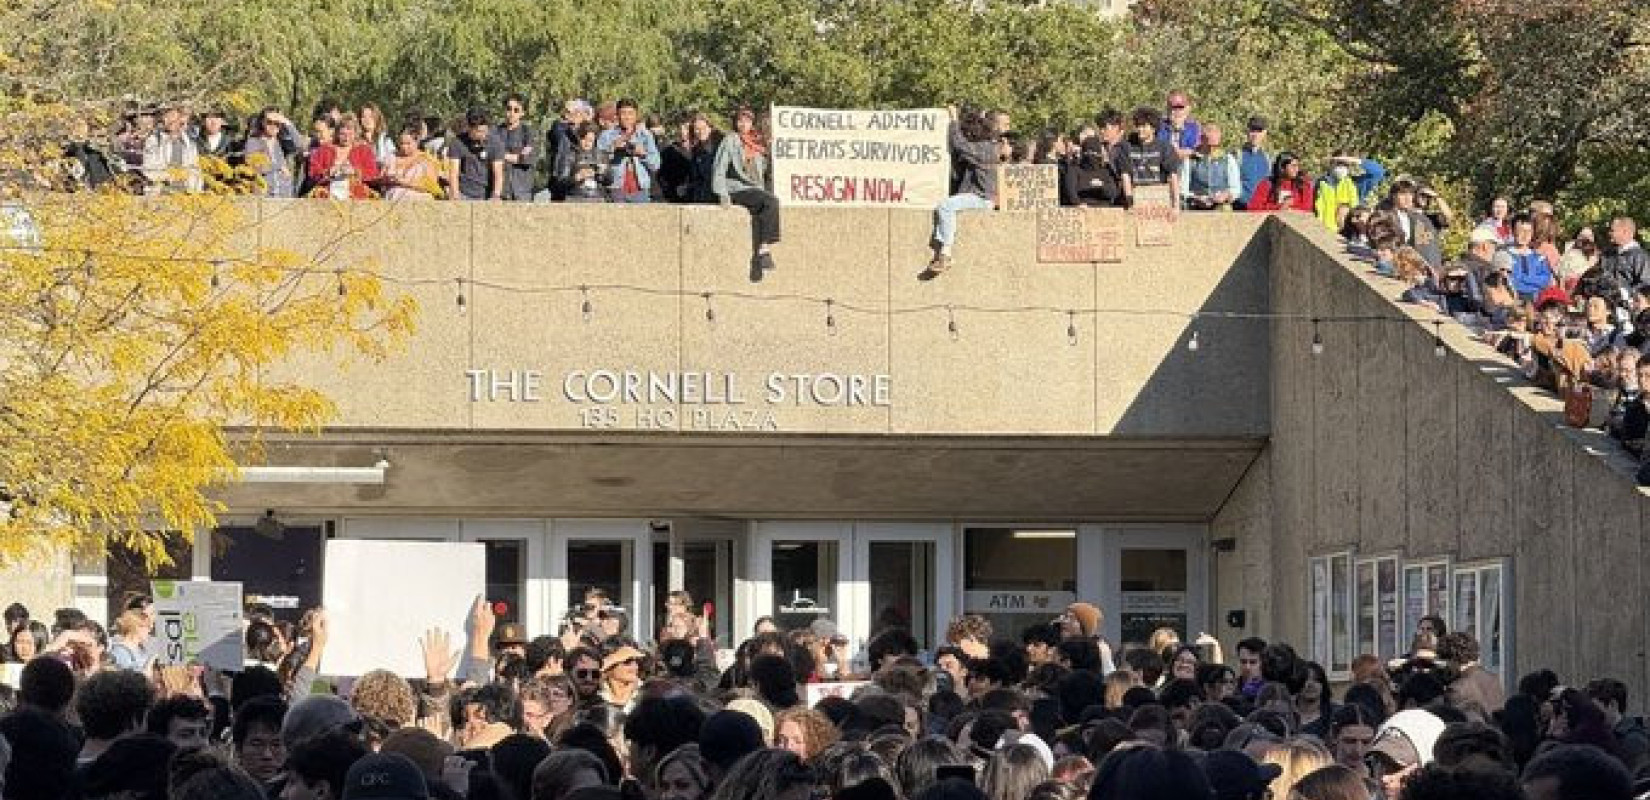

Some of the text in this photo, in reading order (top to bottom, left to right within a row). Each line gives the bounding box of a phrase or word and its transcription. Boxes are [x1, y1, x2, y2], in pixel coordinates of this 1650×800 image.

[778, 110, 937, 131] CORNELL ADMIN
[775, 137, 942, 165] BETRAYS SURVIVORS
[790, 173, 909, 203] RESIGN NOW.
[465, 368, 892, 407] THE CORNELL STORE
[578, 406, 778, 431] 135 HO PLAZA
[988, 595, 1025, 609] ATM
